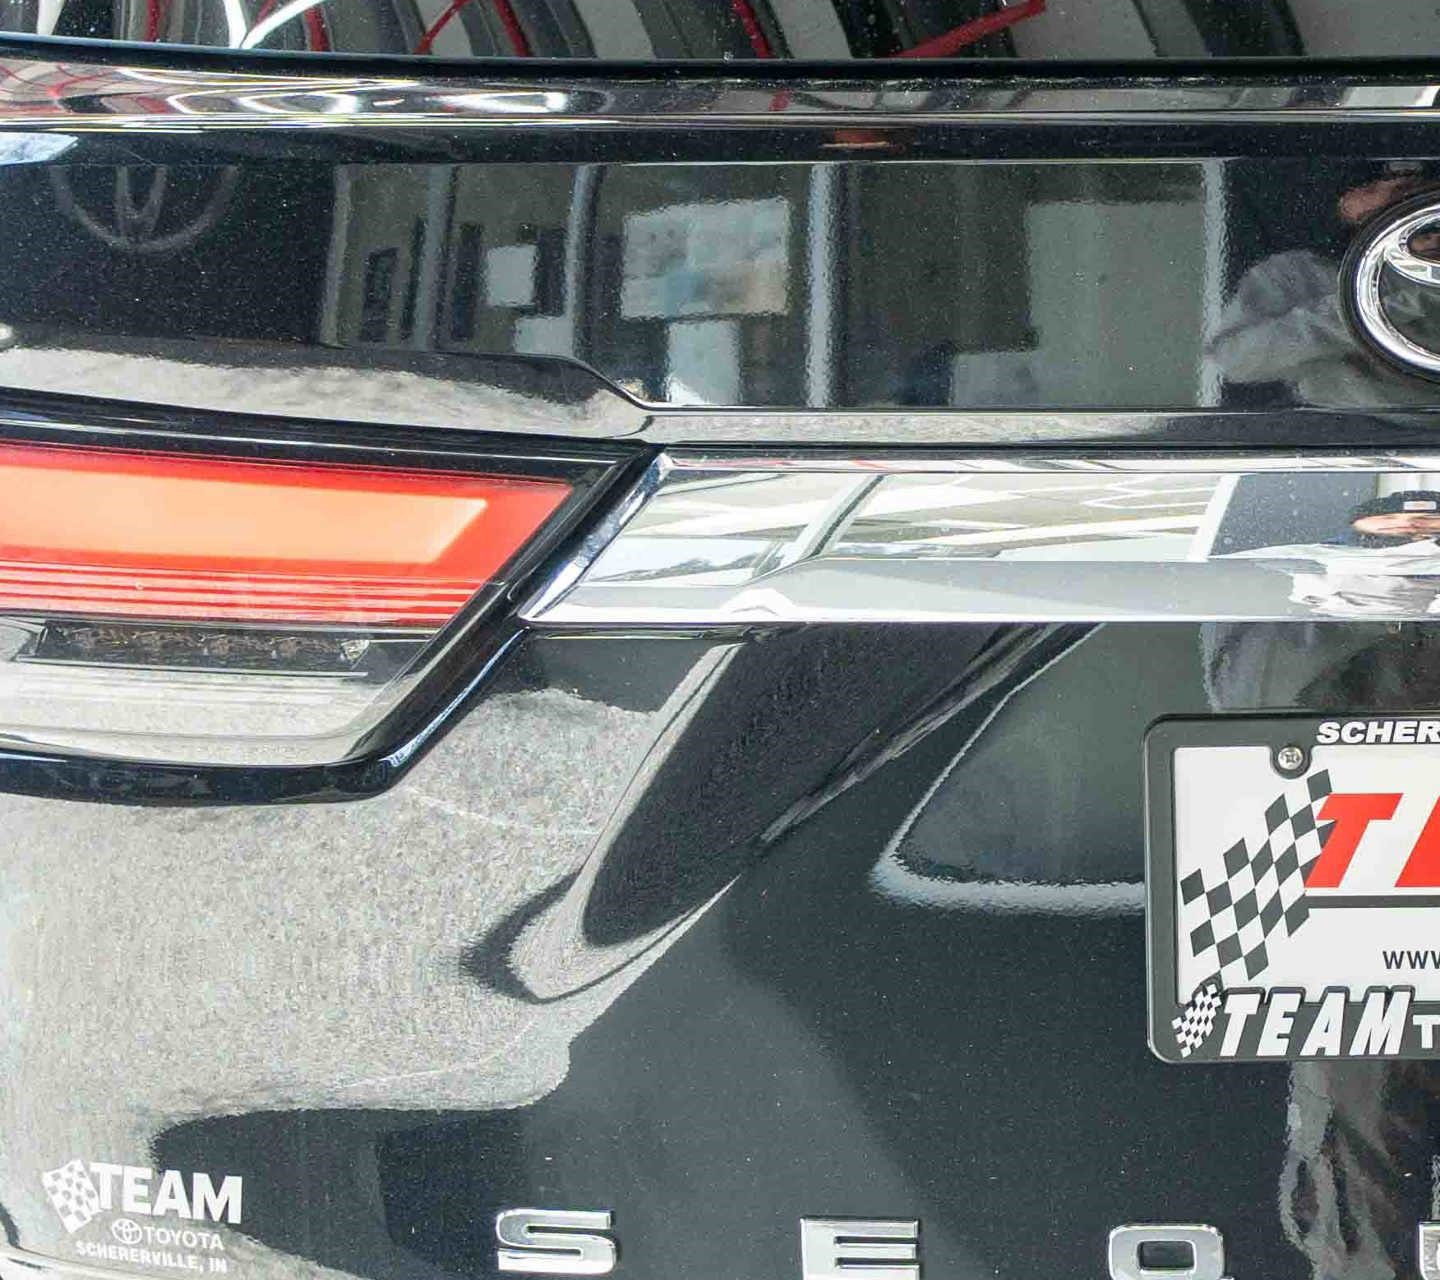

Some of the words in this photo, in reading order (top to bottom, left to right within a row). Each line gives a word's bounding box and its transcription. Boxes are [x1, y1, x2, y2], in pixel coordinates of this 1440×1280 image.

[90, 1162, 243, 1224] TEAM
[144, 1226, 224, 1251] TOYOTA
[75, 1240, 205, 1274] SCHERERVILLE,
[207, 1256, 228, 1274] IN
